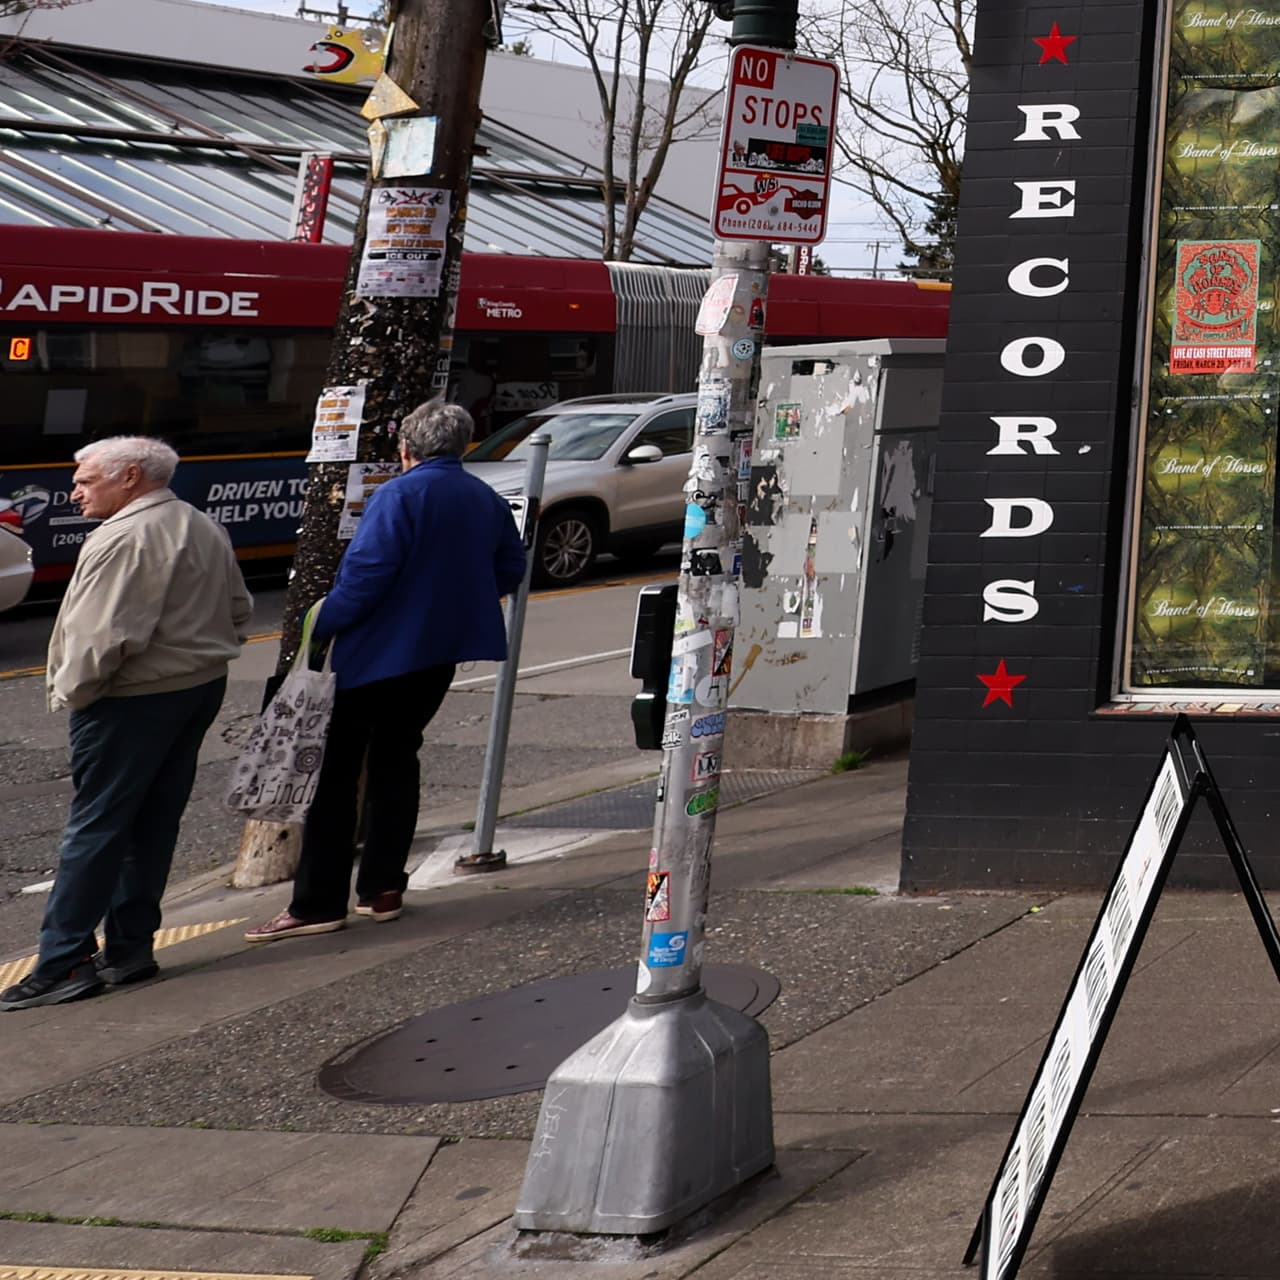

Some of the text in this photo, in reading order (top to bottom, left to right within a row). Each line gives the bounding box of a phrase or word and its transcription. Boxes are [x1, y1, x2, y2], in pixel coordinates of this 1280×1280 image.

[1180, 11, 1229, 30] Band
[1226, 9, 1246, 30] of
[739, 55, 770, 83] NO
[741, 95, 823, 131] STOPS
[1177, 139, 1280, 165] Band of Horses
[0, 276, 259, 317] APIDRIDE
[486, 308, 523, 319] METRO
[978, 103, 1083, 624] RECORDS
[1156, 455, 1267, 482] Band of Horses
[206, 480, 285, 501] DRIVEN
[205, 503, 261, 524] HELP
[1149, 597, 1260, 625] Band of Horses
